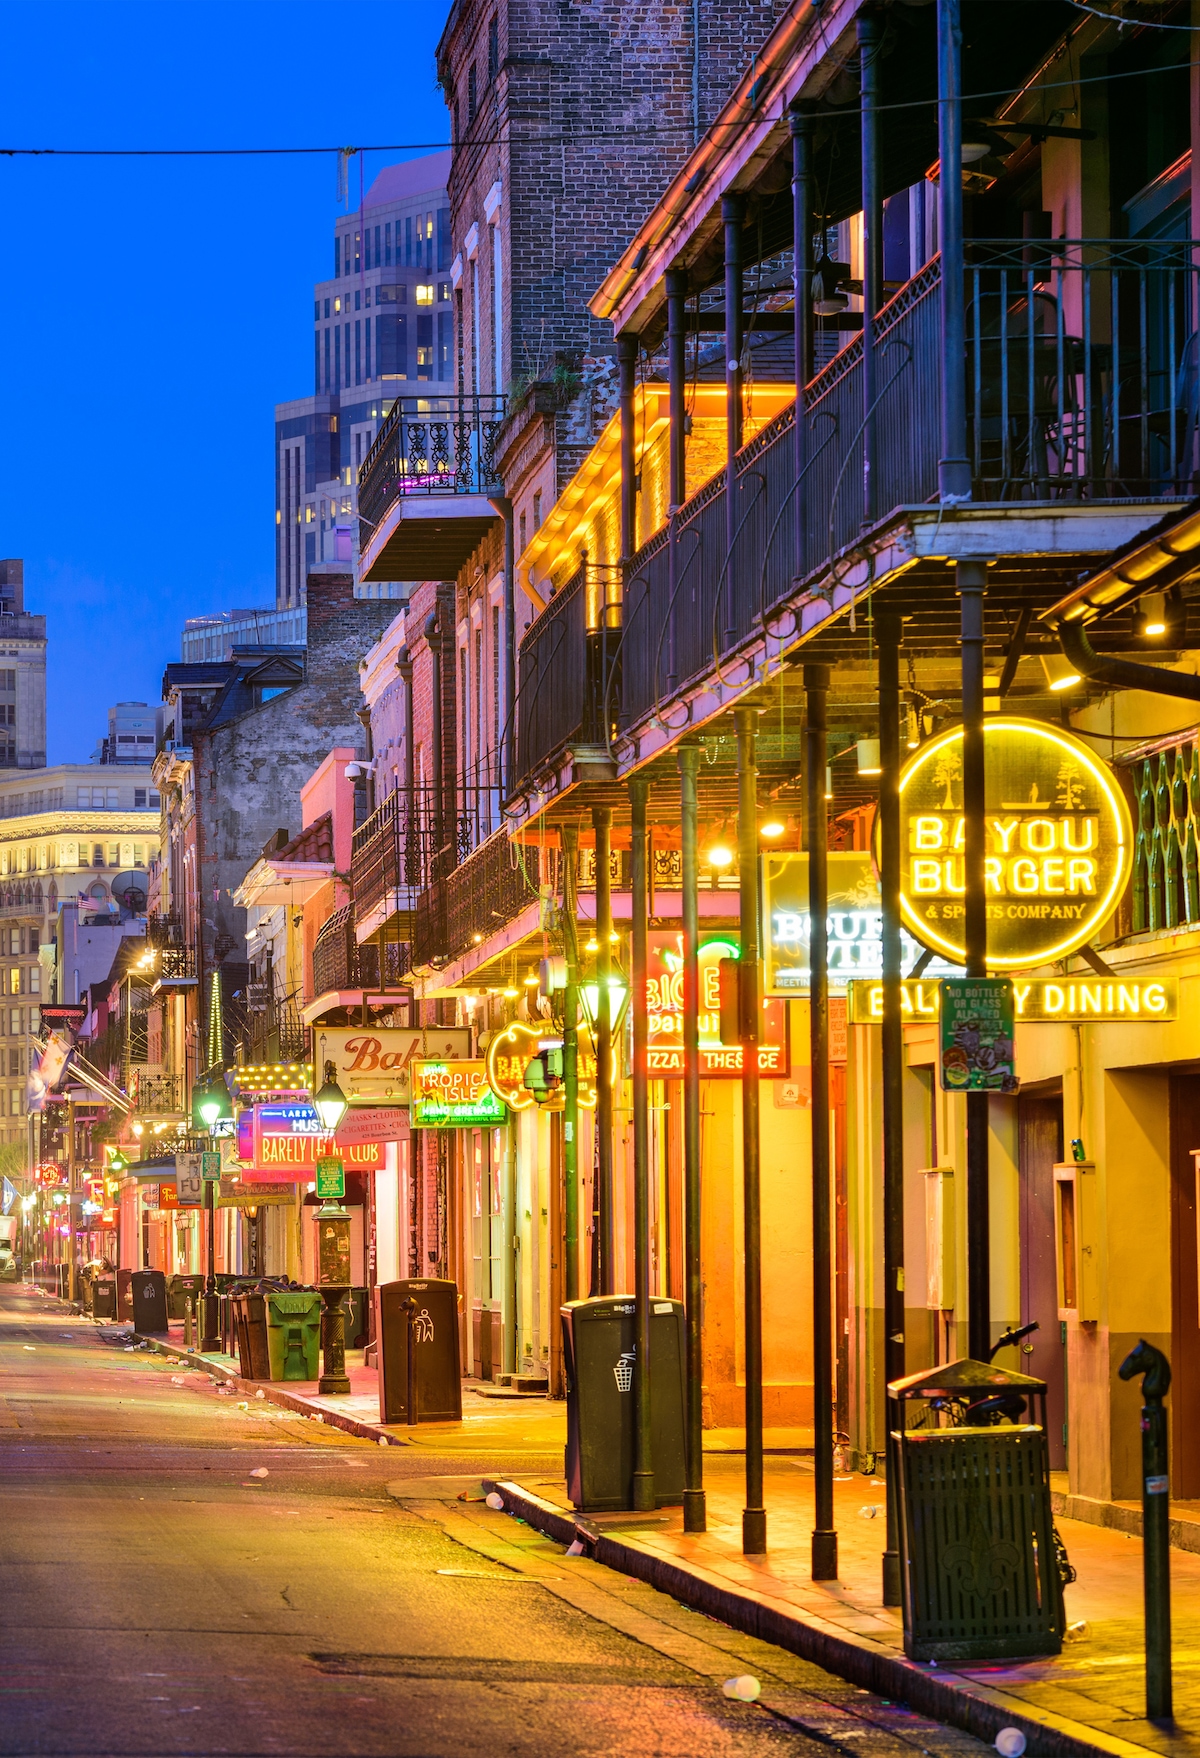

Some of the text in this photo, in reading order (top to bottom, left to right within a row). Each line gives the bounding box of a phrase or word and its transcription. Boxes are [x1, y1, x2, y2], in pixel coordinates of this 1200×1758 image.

[1006, 903, 1087, 919] COMPANY
[776, 978, 810, 987] MEETIN
[949, 988, 1007, 998] NO BOTTLES
[1045, 984, 1166, 1013] DINING
[418, 1072, 488, 1088] TROPICA
[444, 1087, 478, 1101] ISLE
[282, 1108, 314, 1118] LARRY
[392, 1120, 410, 1129] CIGA
[262, 1137, 307, 1163] BARELY
